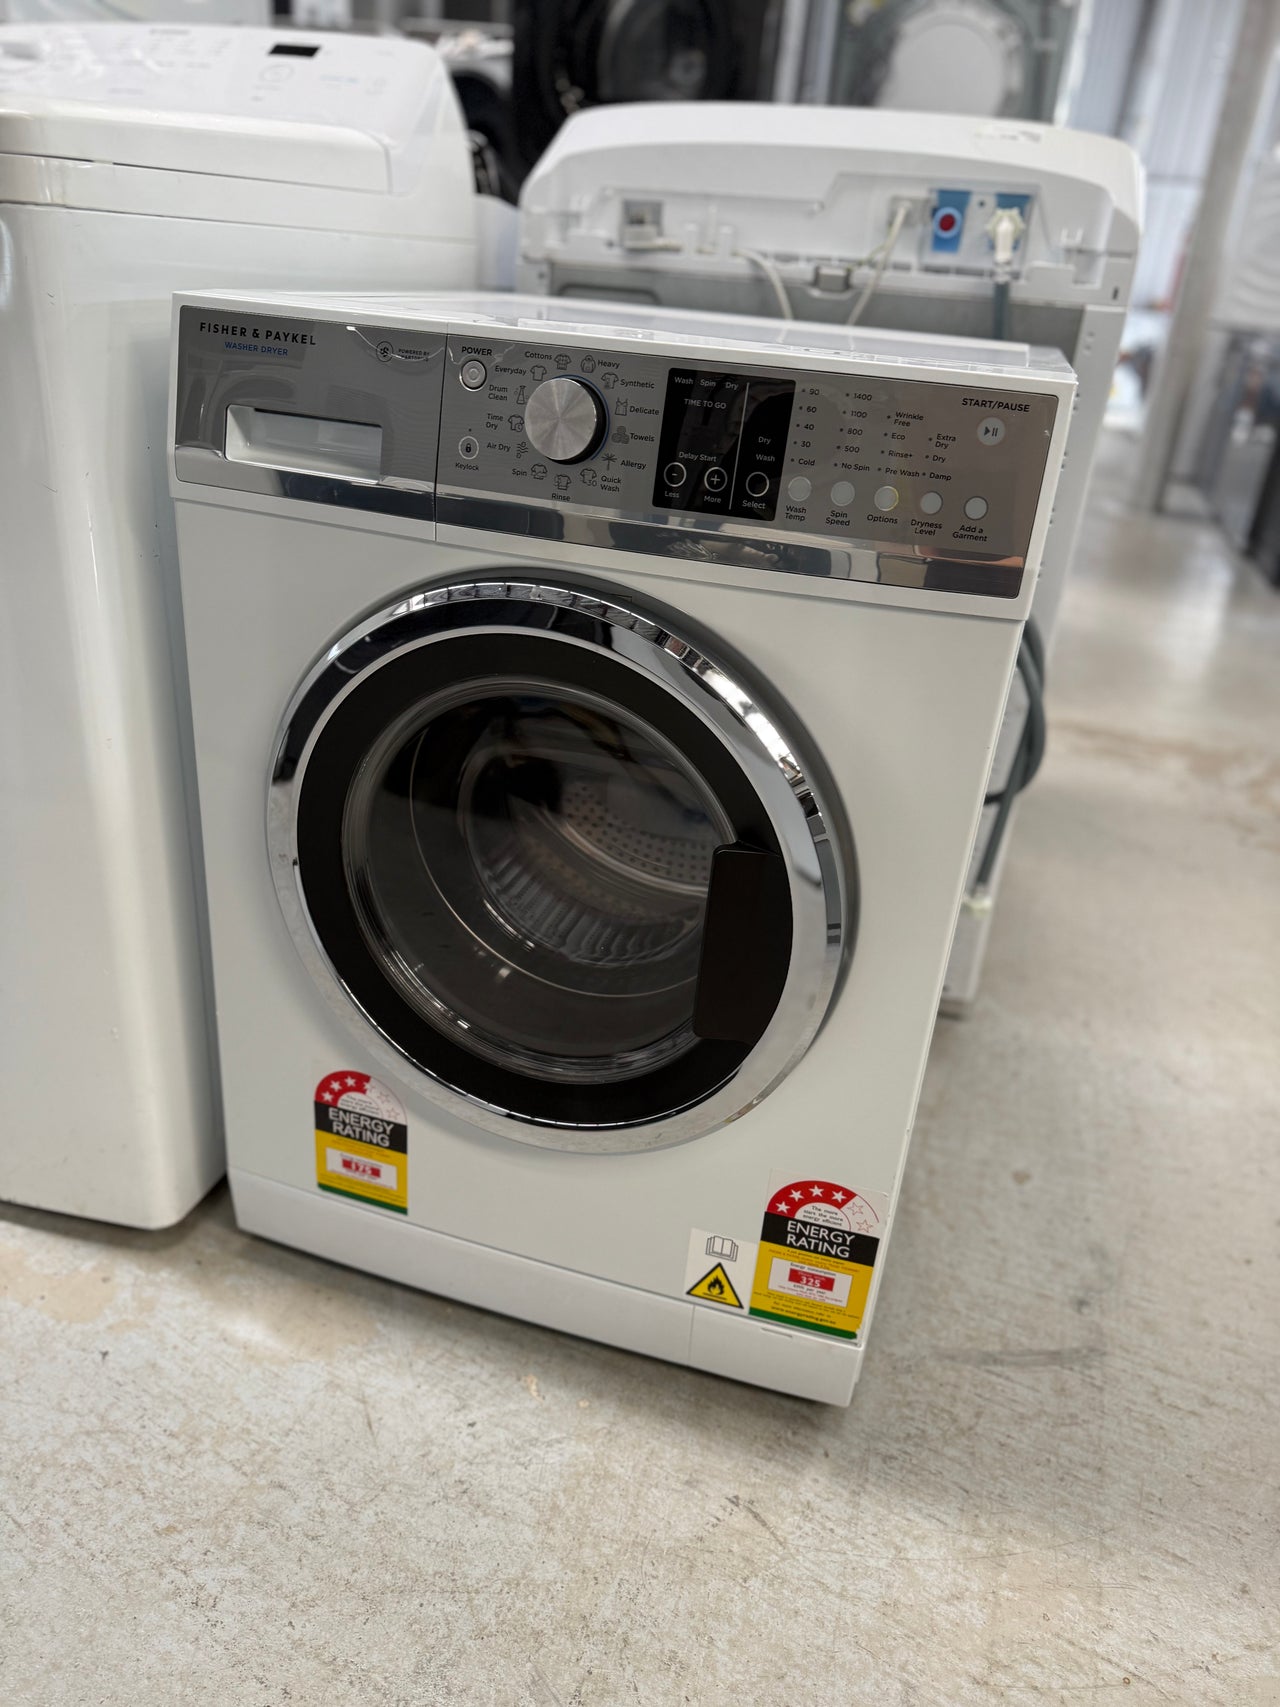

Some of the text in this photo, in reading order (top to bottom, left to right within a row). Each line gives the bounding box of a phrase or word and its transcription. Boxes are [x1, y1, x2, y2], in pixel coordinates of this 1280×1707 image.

[200, 322, 316, 345] FISHER & PAYKEL
[224, 341, 288, 356] WASHER DRYER
[461, 346, 492, 356] POWER
[524, 351, 553, 360] Cottons
[597, 360, 620, 369] Heavy
[495, 365, 527, 376] Everyday
[620, 379, 655, 389] Synthetic
[674, 376, 694, 385] Wash
[700, 379, 716, 387] Spin
[725, 382, 739, 391] Dry
[854, 392, 872, 401] 1400
[684, 398, 727, 409] TIME TO GO
[961, 398, 1031, 413] START/PAUSE
[629, 405, 660, 415] Delicate
[851, 410, 867, 418] 1100
[487, 413, 503, 421] Time
[895, 411, 924, 421] Wrinkle
[485, 422, 498, 430] Dry
[894, 419, 911, 427] Free
[847, 428, 863, 436] 800
[629, 432, 655, 442] Towels
[758, 436, 771, 445] Dry
[936, 433, 956, 442] Extra
[498, 443, 511, 452] Dry
[844, 445, 860, 453] 500
[935, 441, 949, 449] Dry
[679, 451, 717, 462] Delay Start
[755, 454, 775, 462] Wash
[888, 450, 913, 459] Rinse+
[798, 458, 815, 466] Cold
[932, 455, 946, 464] Dry
[455, 462, 479, 471] Keylock
[620, 459, 647, 470] Allergy
[841, 462, 870, 472] No Spin
[512, 468, 527, 476] Spin
[885, 467, 920, 477] Pre Wash
[601, 475, 622, 484] Quick
[929, 472, 952, 482] Damp
[600, 484, 620, 492] Wash
[552, 492, 570, 502] Rinse
[742, 500, 766, 509] Select
[785, 505, 806, 514] Wash
[785, 512, 806, 522] Temp
[830, 510, 848, 519] Spin
[866, 514, 898, 524] Options
[825, 517, 851, 526] Speed
[910, 519, 943, 529] Dryness
[914, 528, 936, 536] Level
[959, 525, 977, 534] Add
[952, 531, 988, 542] Garment
[328, 1107, 394, 1135] ENERGY
[332, 1121, 390, 1147] RATING
[803, 1214, 842, 1226] energy efficient
[787, 1220, 855, 1245] ENERGY
[786, 1233, 850, 1258] RATING
[800, 1276, 820, 1287] 325
